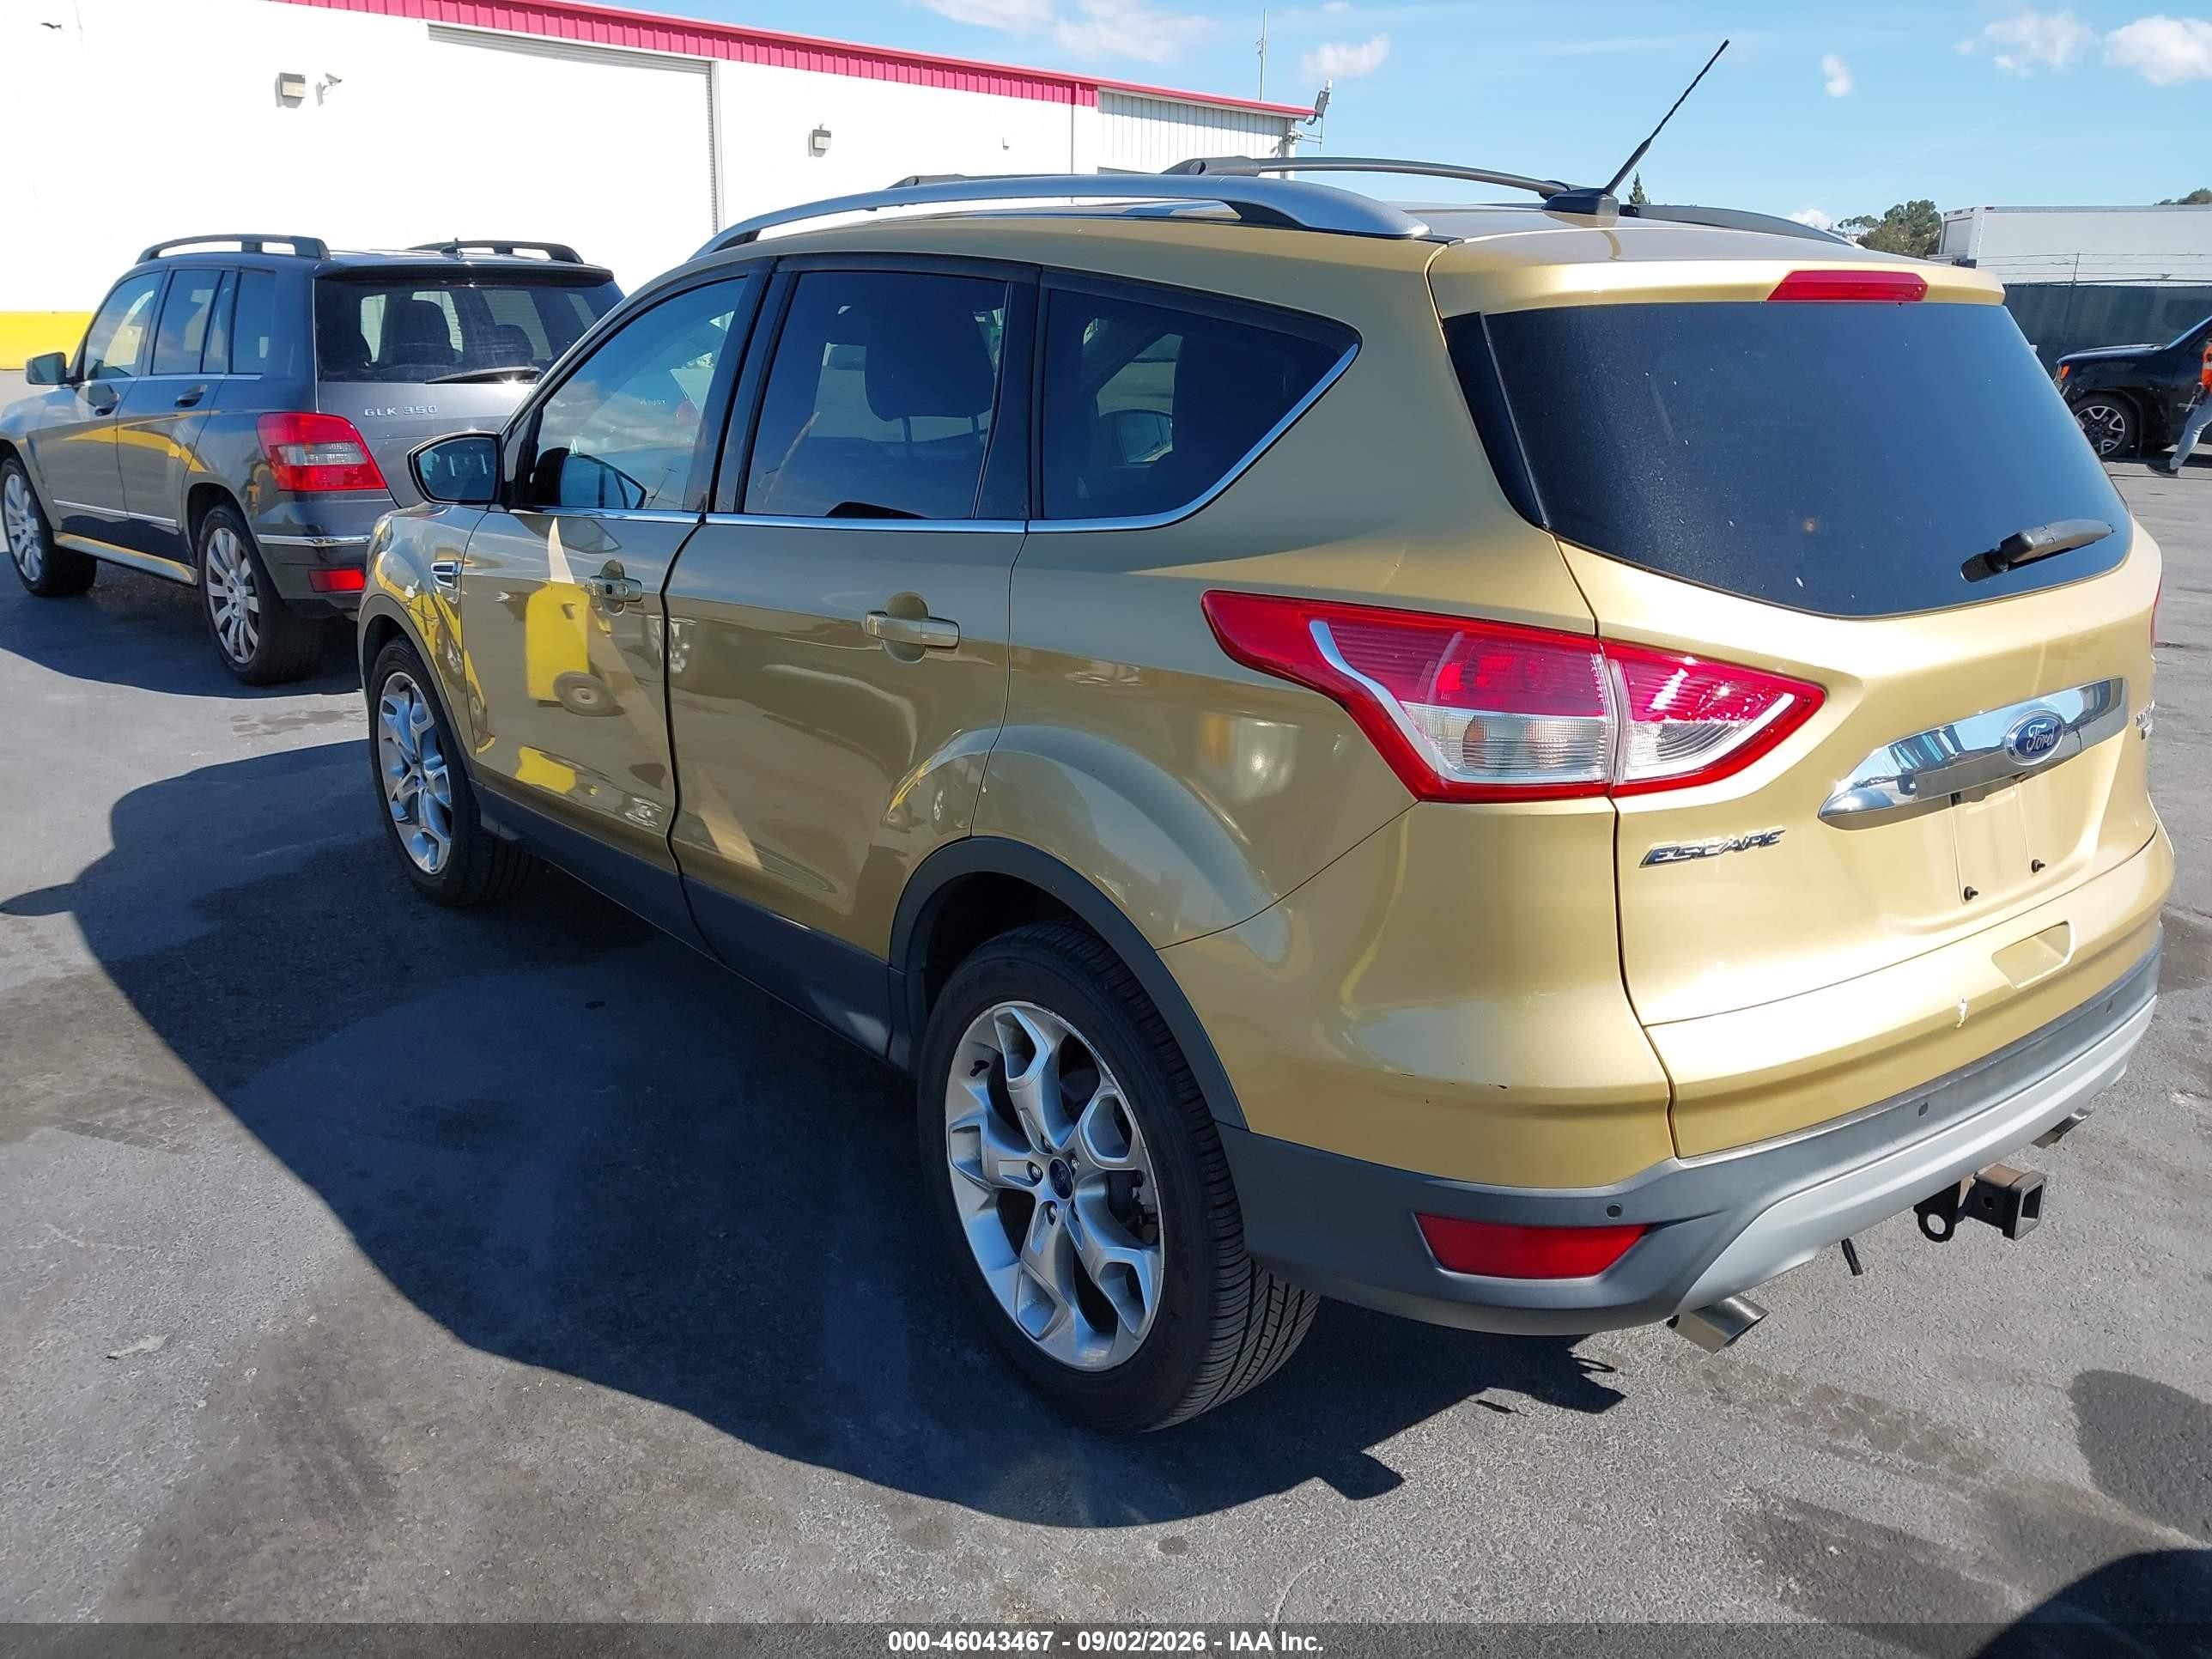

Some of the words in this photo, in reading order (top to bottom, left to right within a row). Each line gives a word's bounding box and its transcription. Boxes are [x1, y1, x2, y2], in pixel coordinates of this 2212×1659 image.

[364, 407, 398, 417] GLK
[403, 404, 438, 416] 350
[2026, 722, 2056, 753] Ford
[1639, 826, 1786, 867] ESCAPE
